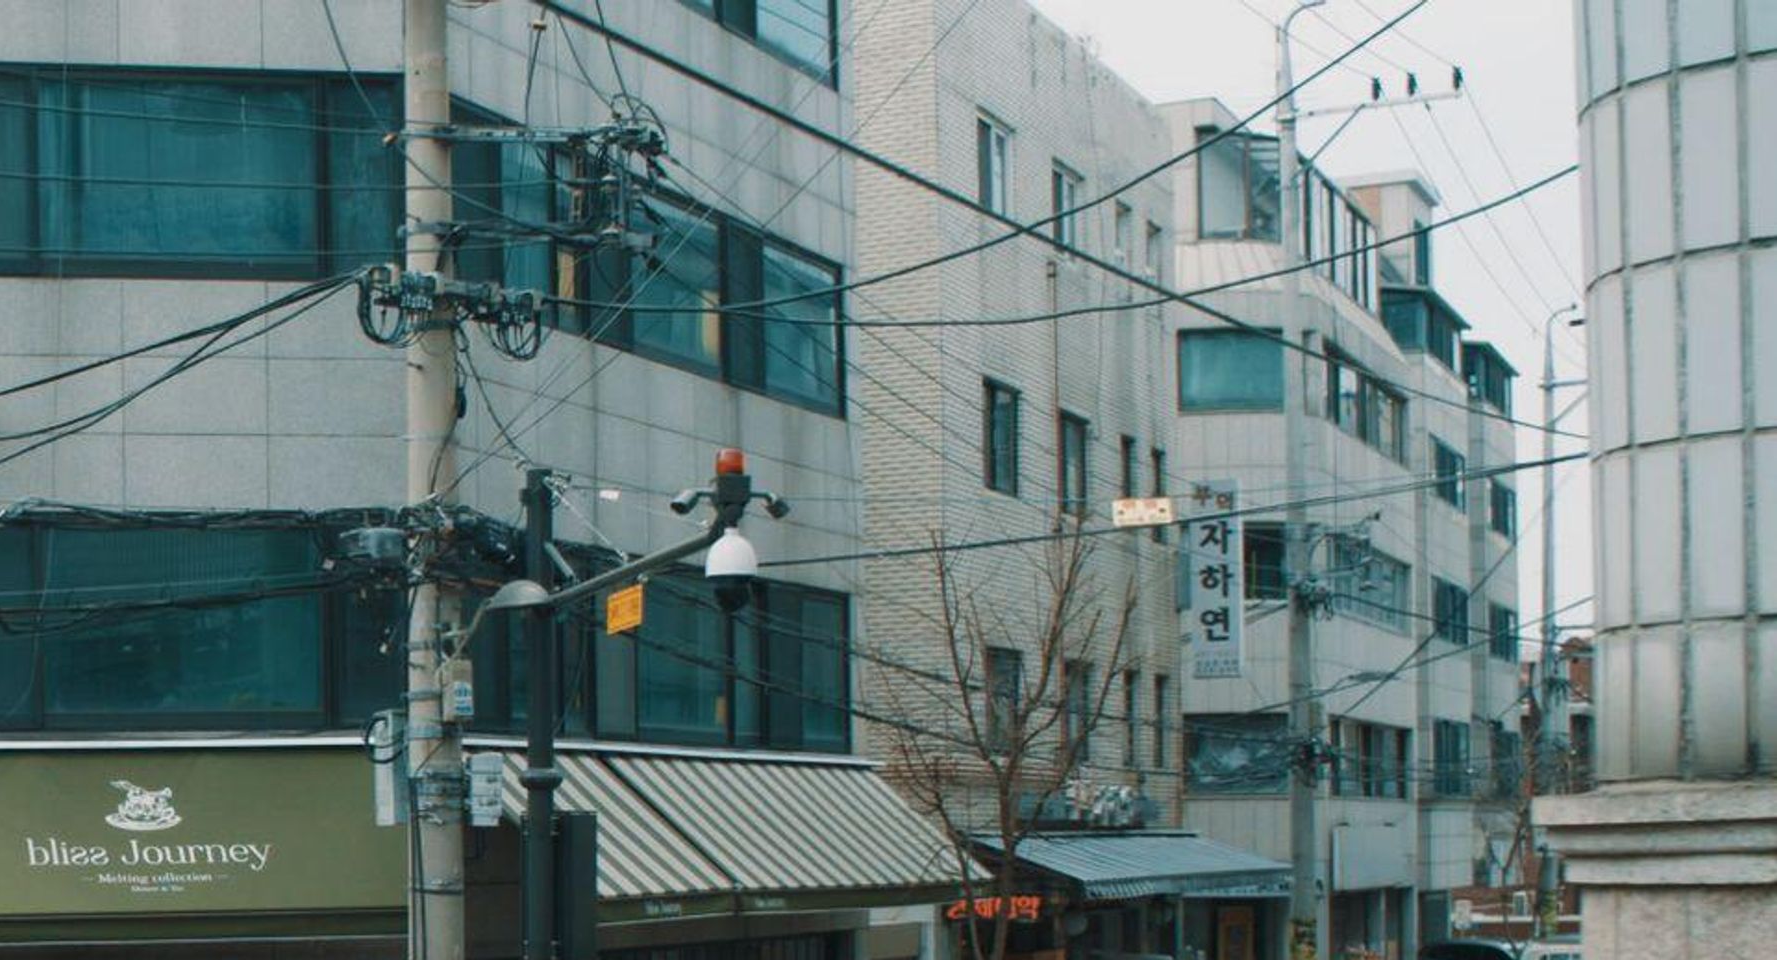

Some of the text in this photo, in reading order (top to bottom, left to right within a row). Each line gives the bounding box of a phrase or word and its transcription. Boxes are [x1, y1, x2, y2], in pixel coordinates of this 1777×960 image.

[1199, 520, 1234, 642] 자하연
[26, 837, 271, 871] bliss Journey
